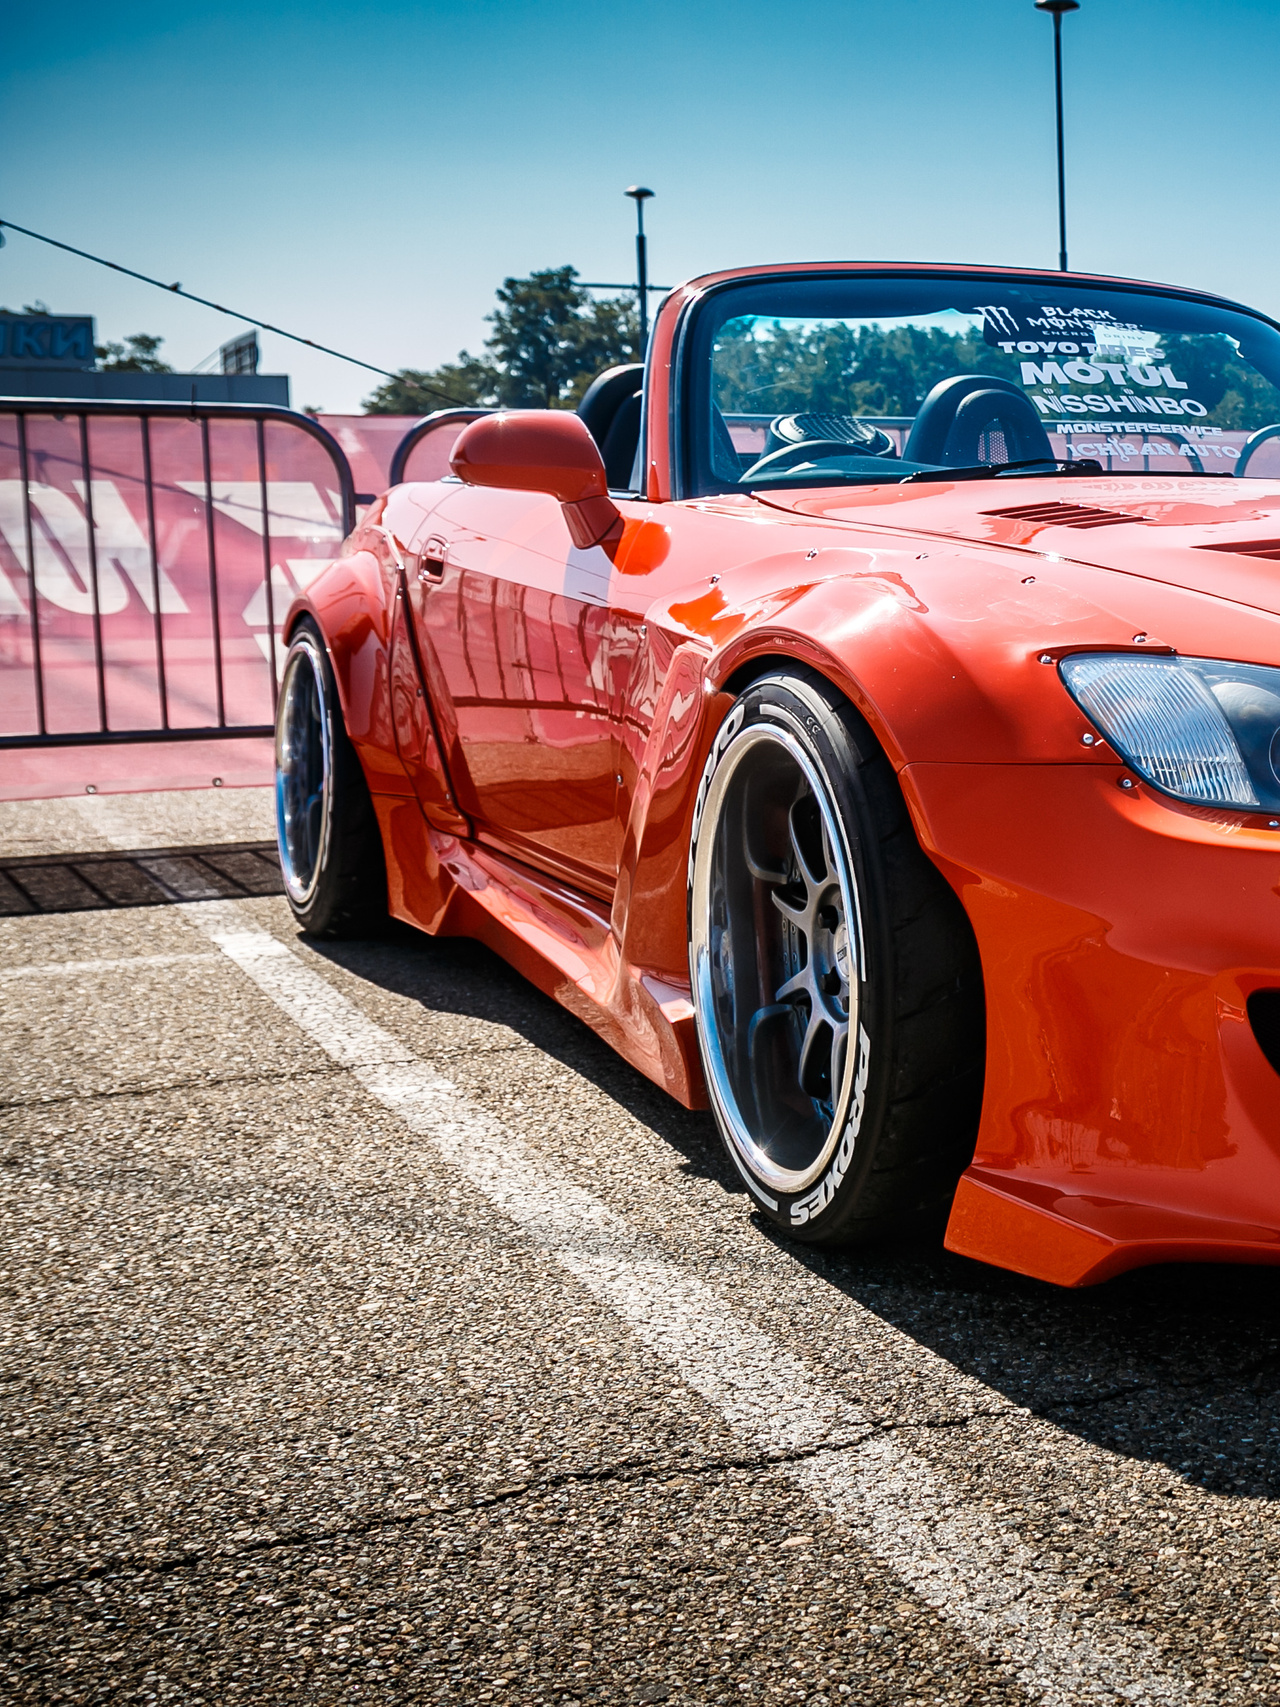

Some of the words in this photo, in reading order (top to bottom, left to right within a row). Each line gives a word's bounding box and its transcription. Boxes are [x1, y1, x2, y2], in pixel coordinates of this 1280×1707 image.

[1041, 306, 1117, 321] BLACK
[1103, 333, 1145, 341] DRINK
[998, 341, 1079, 354] TOYO
[1081, 342, 1166, 360] TIRES
[1020, 361, 1188, 390] MOTUL
[1056, 423, 1224, 437] MONSTERSERVICE
[1178, 443, 1242, 459] AUTO
[790, 1020, 871, 1226] PROXES
